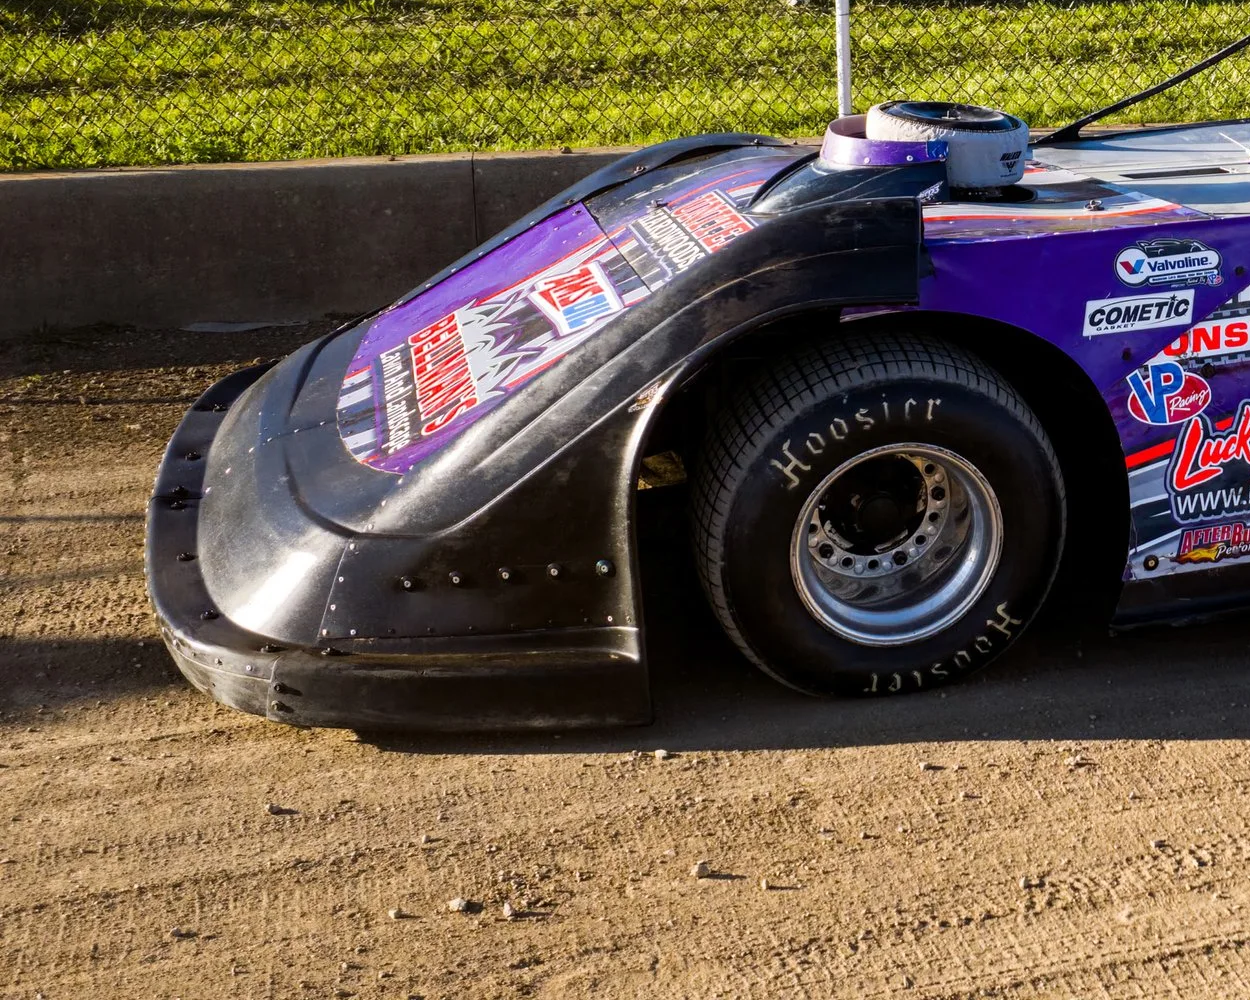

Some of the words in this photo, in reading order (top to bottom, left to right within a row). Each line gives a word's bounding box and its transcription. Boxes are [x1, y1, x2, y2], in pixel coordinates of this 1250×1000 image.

[672, 191, 755, 254] UNITE
[1147, 256, 1209, 273] Valvoline
[544, 266, 613, 330] AMSOIL
[1089, 296, 1190, 327] COMETIC
[1096, 322, 1136, 332] GASKET
[380, 343, 406, 379] Lawn
[408, 311, 480, 436] BELLMAN'S
[384, 370, 413, 402] And
[1126, 361, 1185, 426] VP
[1169, 389, 1210, 417] Racing
[381, 391, 416, 455] Landscape
[770, 394, 943, 490] Hoosier
